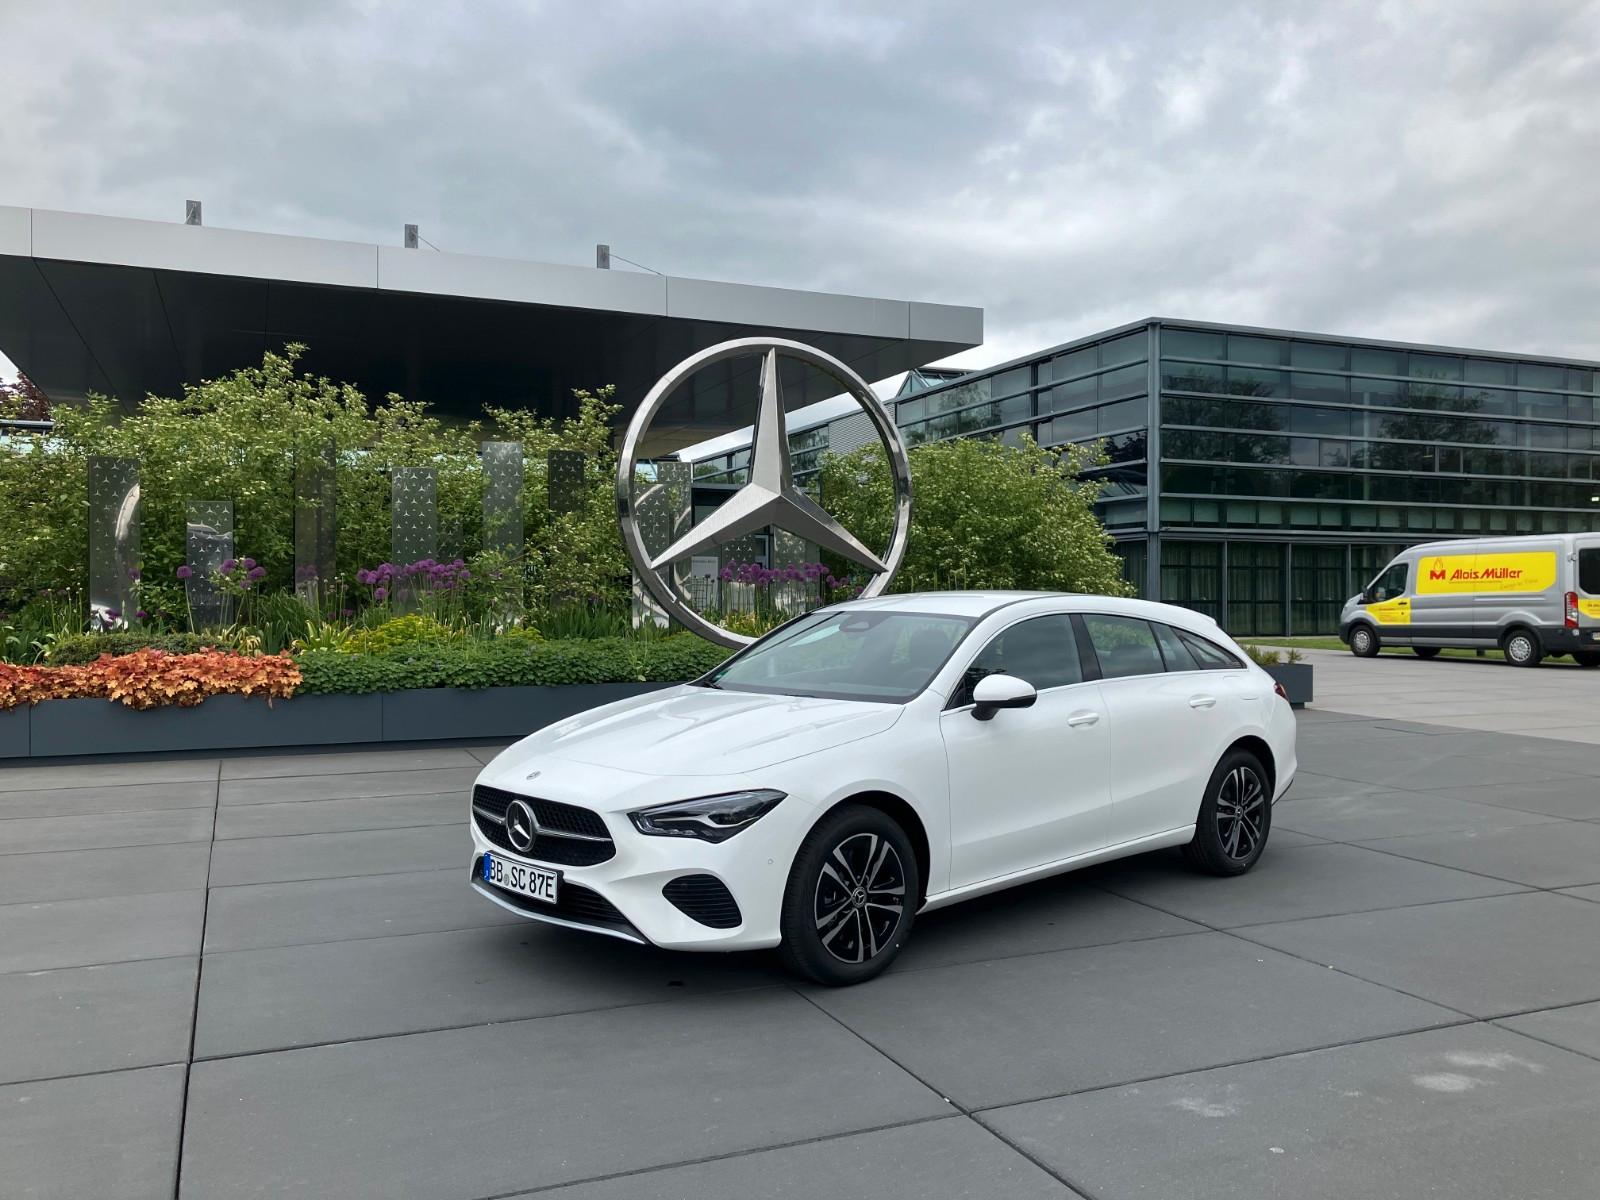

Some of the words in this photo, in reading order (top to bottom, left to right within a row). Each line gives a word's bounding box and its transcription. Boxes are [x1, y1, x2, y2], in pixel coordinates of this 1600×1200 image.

[1450, 569, 1479, 580] Alois
[1480, 568, 1522, 580] Müller
[490, 859, 503, 883] BB
[511, 866, 526, 890] SC
[529, 871, 554, 897] 87E
